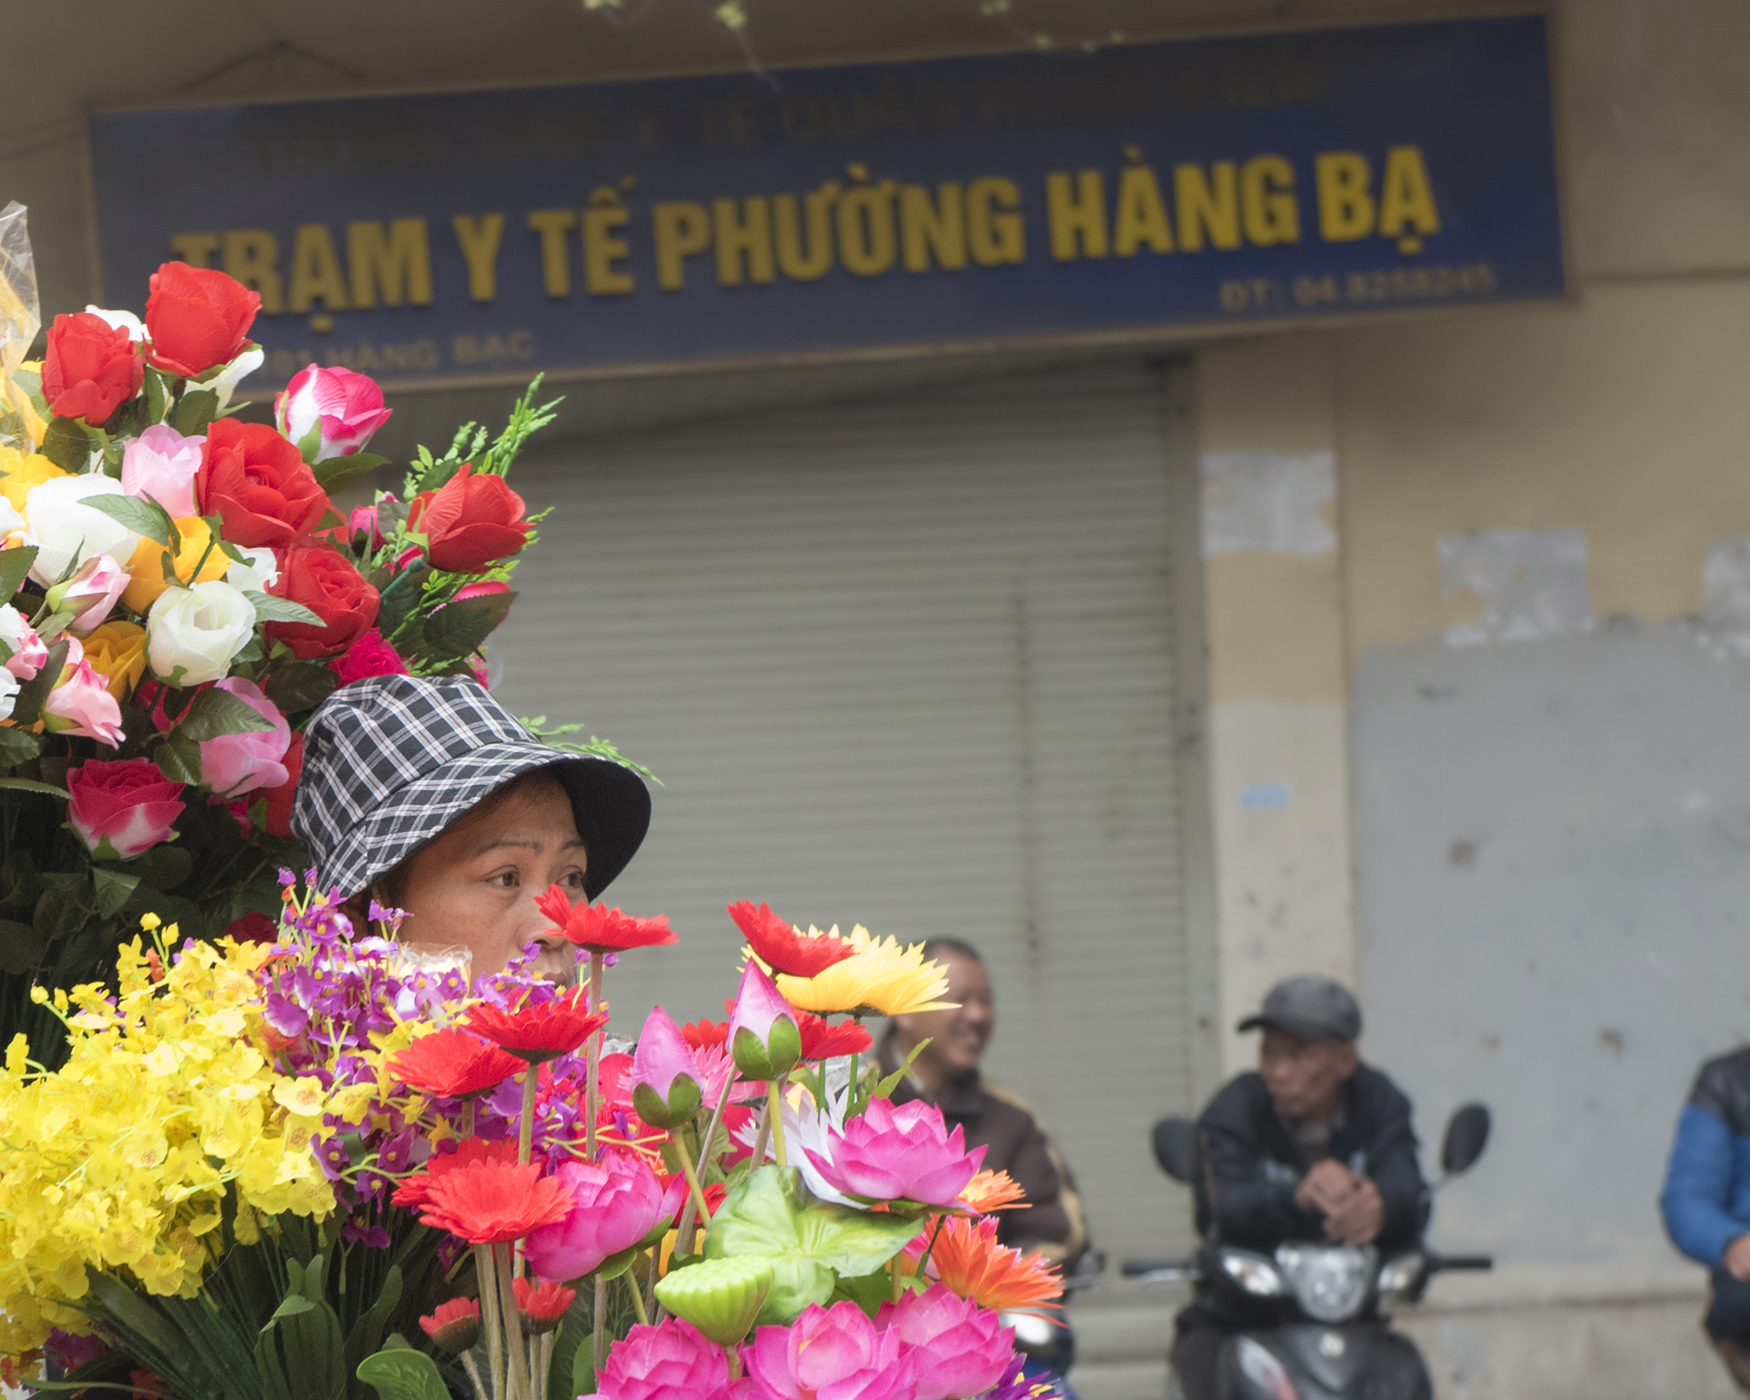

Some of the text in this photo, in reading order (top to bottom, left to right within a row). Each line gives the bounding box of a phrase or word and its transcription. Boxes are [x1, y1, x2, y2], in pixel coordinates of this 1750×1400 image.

[452, 212, 505, 302] Y
[528, 175, 637, 297] TẾ
[653, 163, 1025, 291] PHƯỜNG
[1046, 145, 1301, 262] HÀNG
[1315, 146, 1441, 256] BẠ
